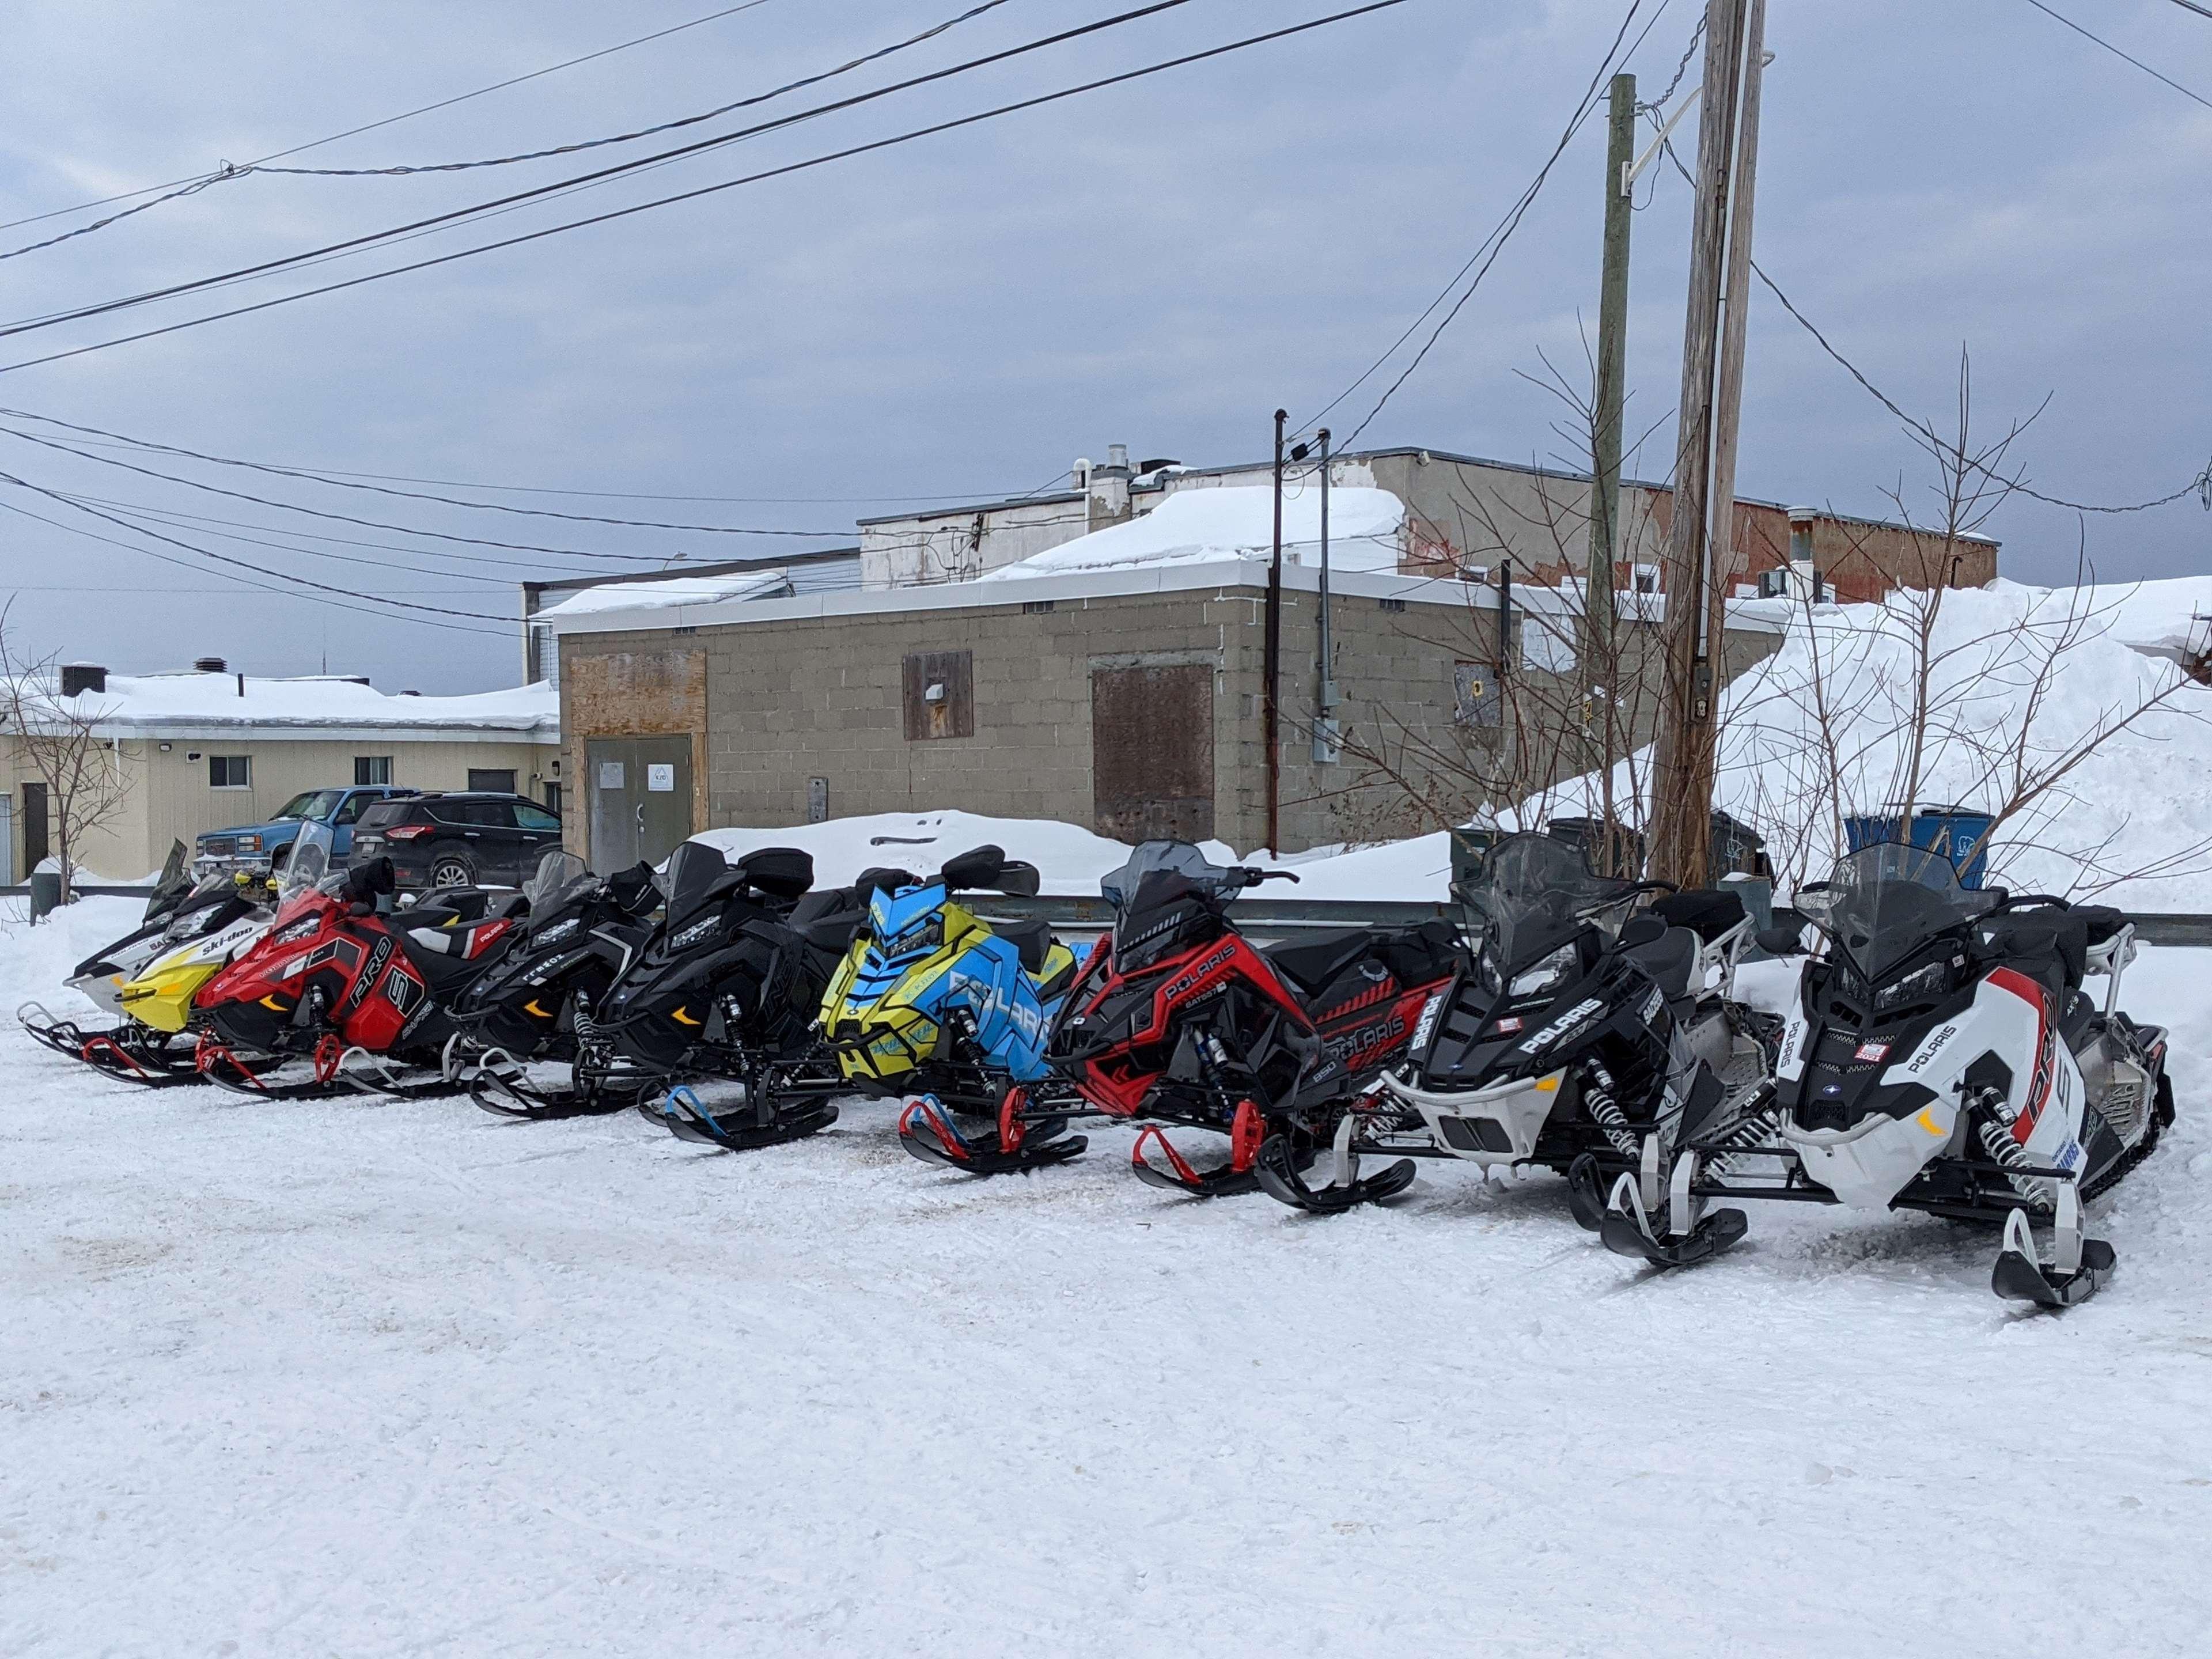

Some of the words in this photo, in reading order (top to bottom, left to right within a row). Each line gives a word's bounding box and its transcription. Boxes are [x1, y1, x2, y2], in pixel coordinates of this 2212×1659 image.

[202, 927, 253, 956] ski-doo
[349, 935, 392, 1008] PRO
[1164, 944, 1236, 1001] POLARIS
[1411, 995, 1442, 1050] POLARIS
[1518, 998, 1604, 1055] POLARIS
[1781, 1021, 1801, 1069] POLARIS
[1907, 1025, 1957, 1074] POLARIS
[1854, 1052, 1880, 1063] 2021
[2028, 992, 2055, 1125] PRO
